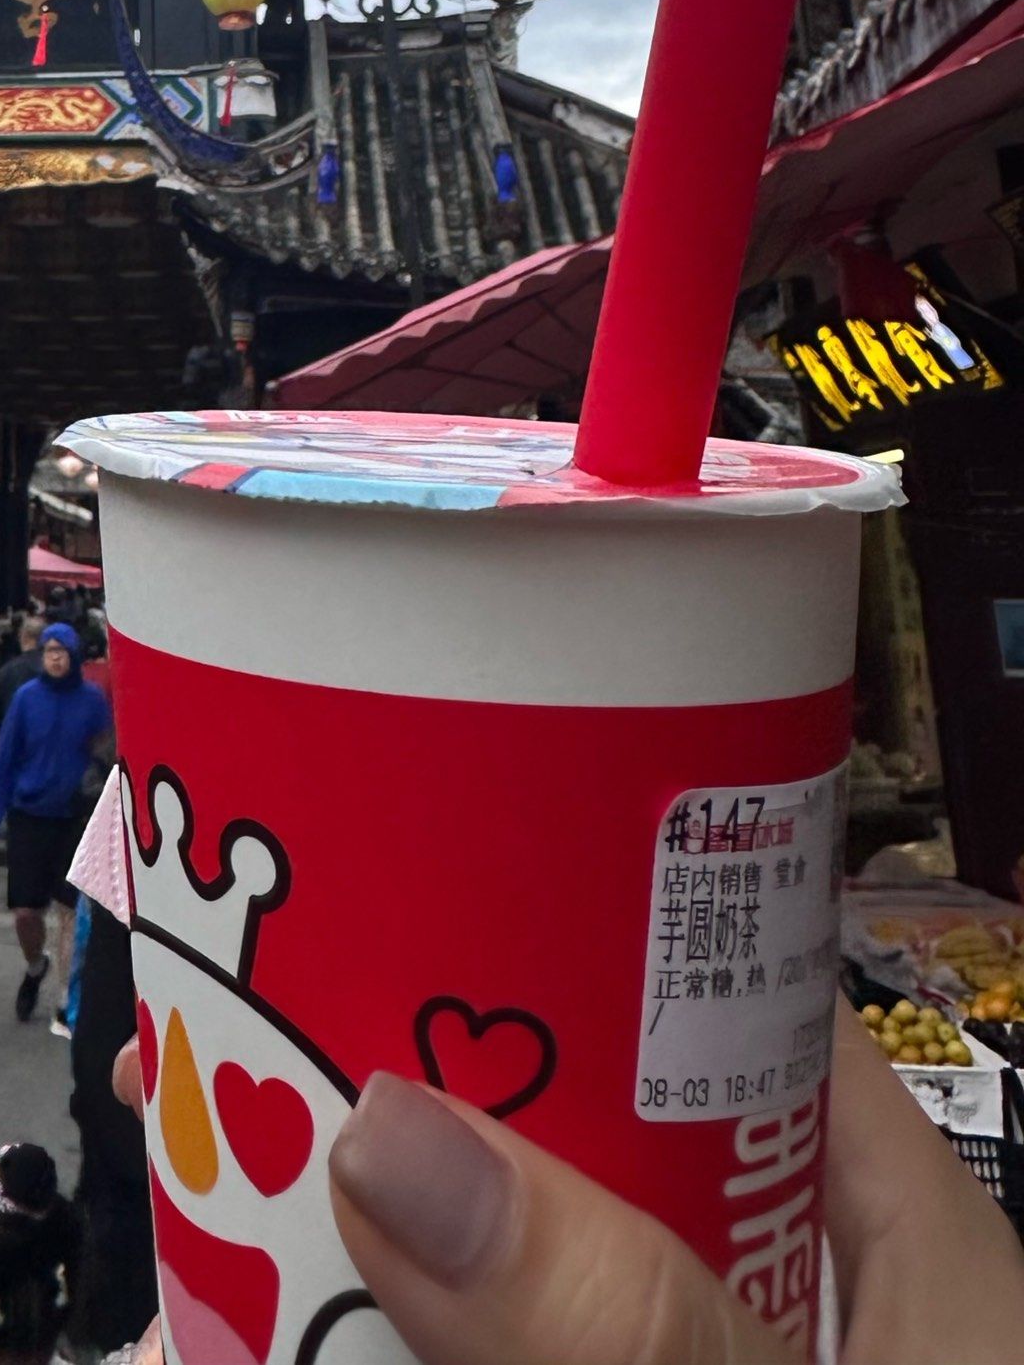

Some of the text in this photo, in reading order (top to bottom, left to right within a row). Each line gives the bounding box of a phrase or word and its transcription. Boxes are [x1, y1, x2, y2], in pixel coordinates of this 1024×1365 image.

[665, 797, 765, 854] #147
[663, 861, 762, 896] 店内销售
[657, 897, 761, 963] 芋圆奶茶
[725, 1068, 776, 1103] 18:47
